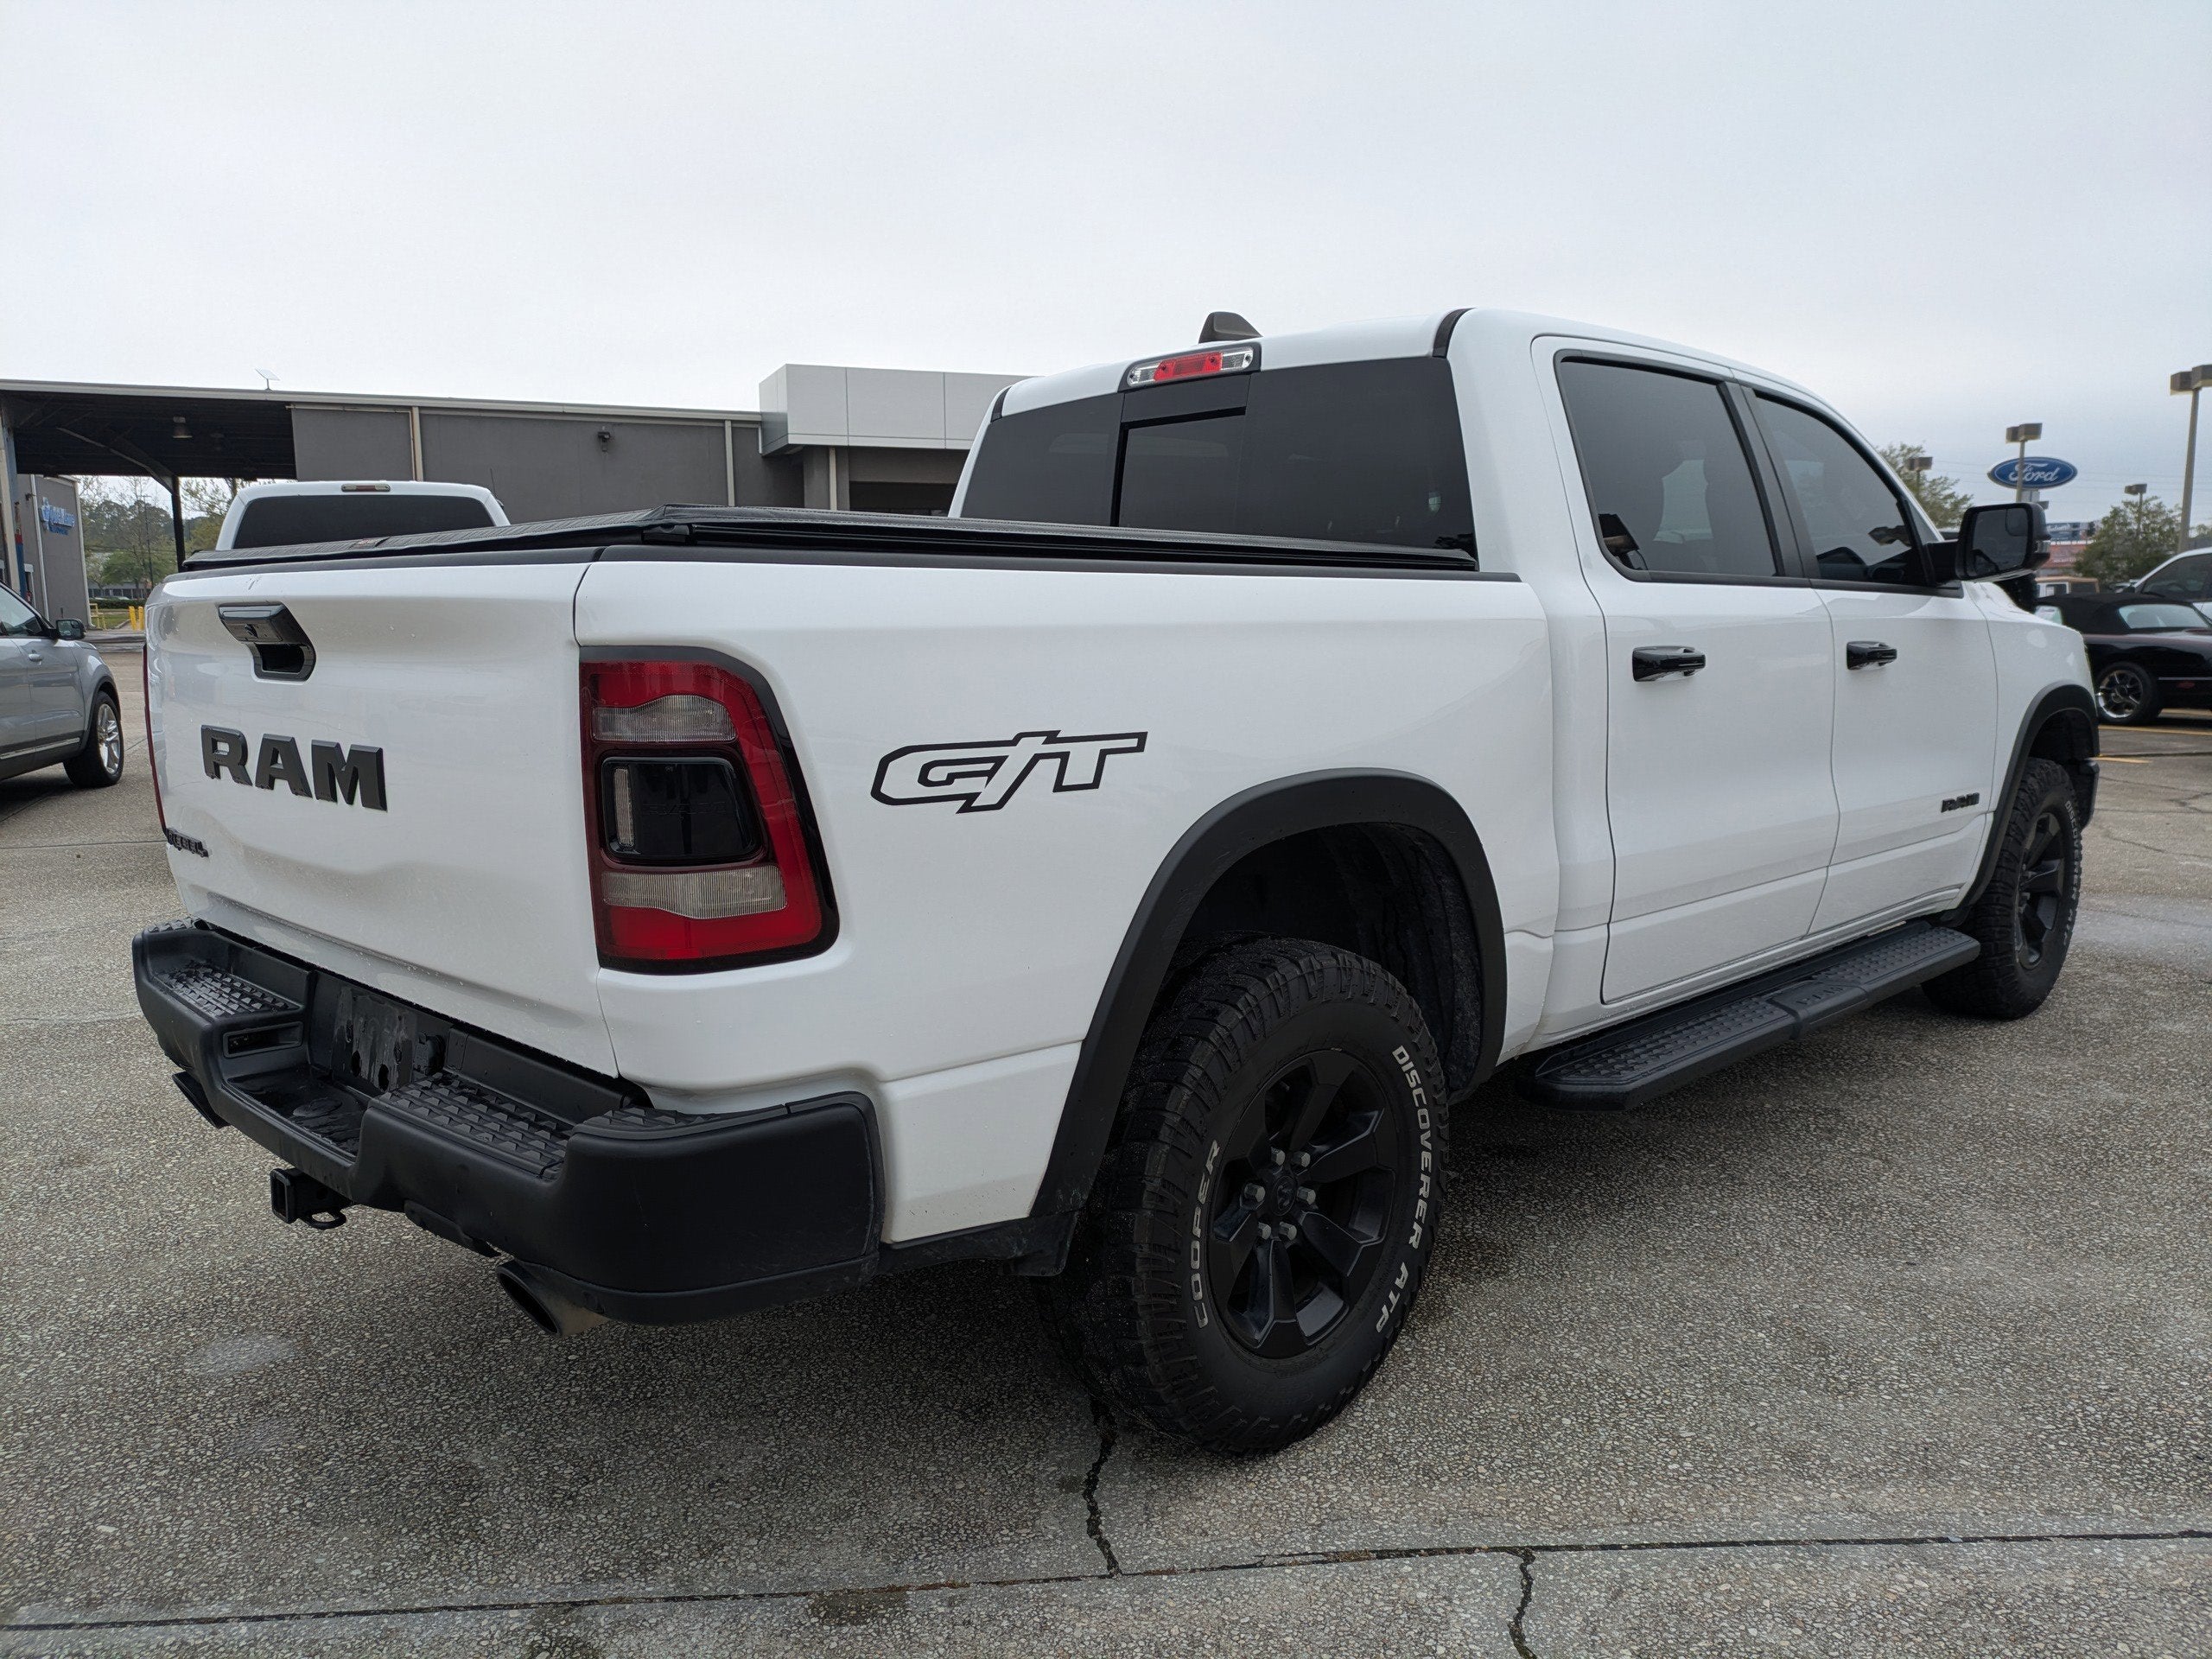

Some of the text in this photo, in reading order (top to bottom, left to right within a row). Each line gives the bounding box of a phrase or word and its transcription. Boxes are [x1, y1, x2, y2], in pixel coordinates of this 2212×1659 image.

[2008, 463, 2060, 482] Ford
[200, 724, 388, 812] RAM
[1190, 1140, 1220, 1329] COOPER
[1376, 1045, 1432, 1333] DISCOVERER ATP
